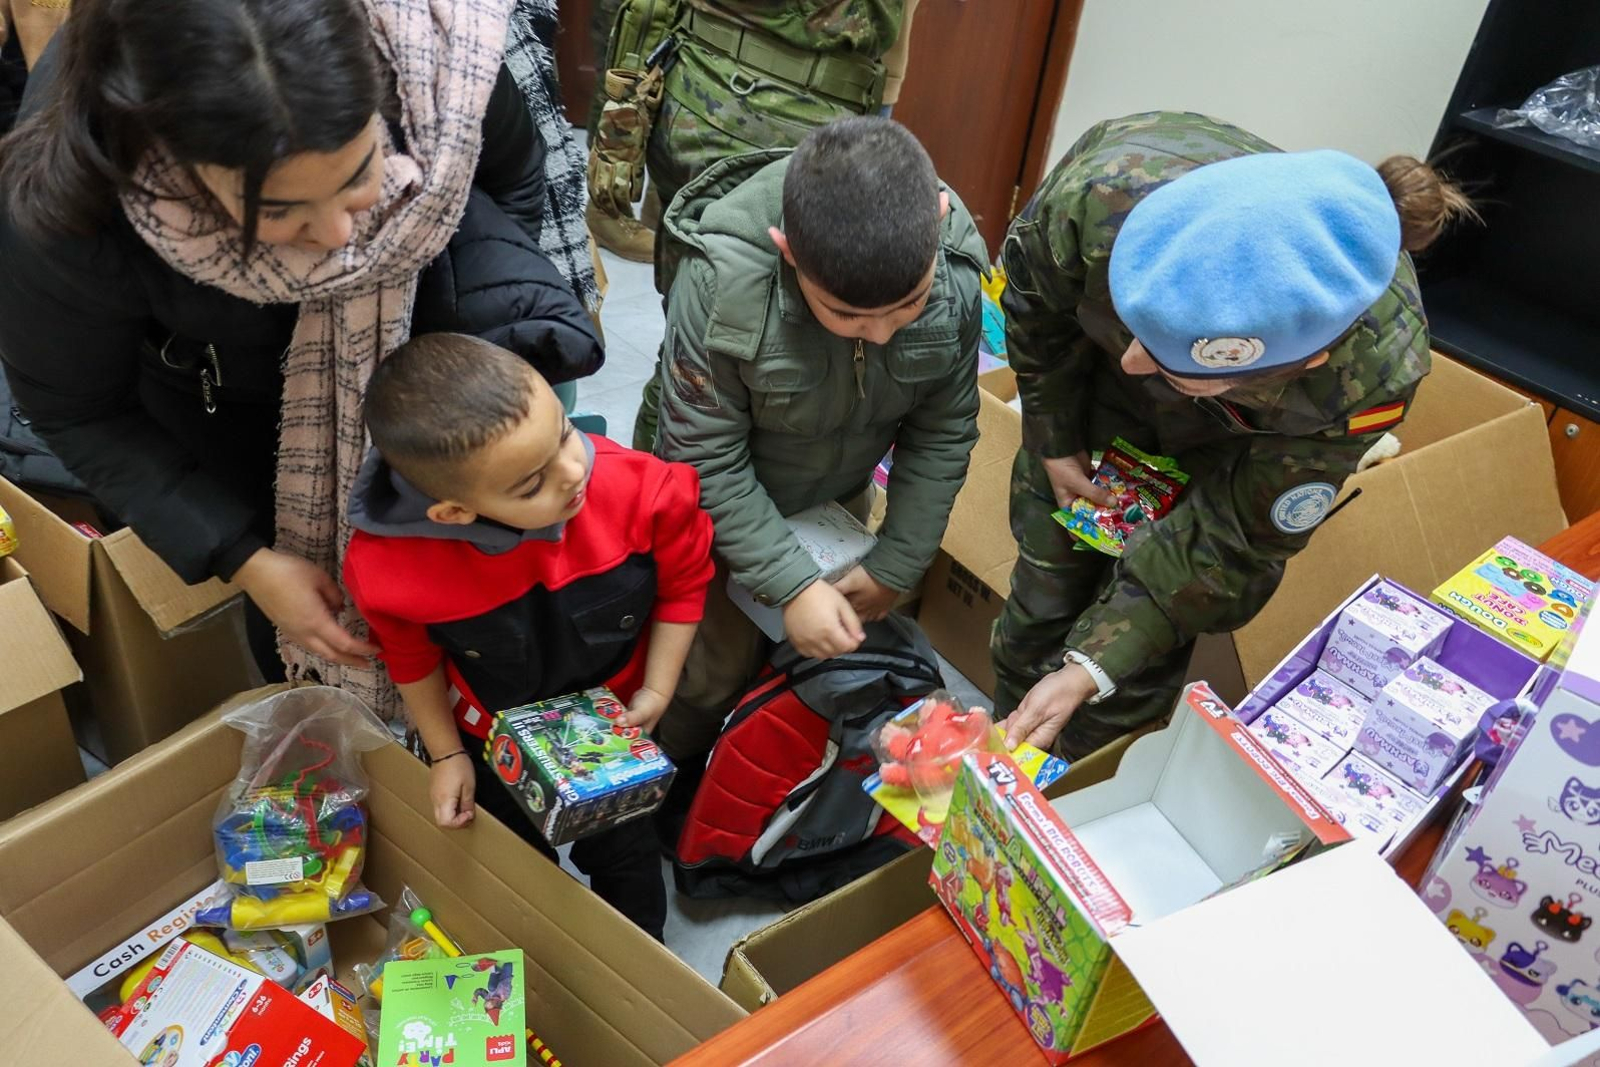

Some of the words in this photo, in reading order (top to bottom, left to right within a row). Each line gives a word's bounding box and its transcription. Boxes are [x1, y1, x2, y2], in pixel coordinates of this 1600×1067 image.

[1449, 591, 1508, 630] DOUGH
[1473, 592, 1528, 627] DONUT
[1329, 646, 1377, 681] APHMAU
[1200, 701, 1224, 719] TV
[1364, 726, 1417, 766] APHMAU
[990, 761, 1017, 784] TV
[93, 943, 145, 978] Cash
[252, 995, 267, 1013] 6-36
[397, 1048, 454, 1067] PARTY
[489, 1046, 512, 1056] APLI
